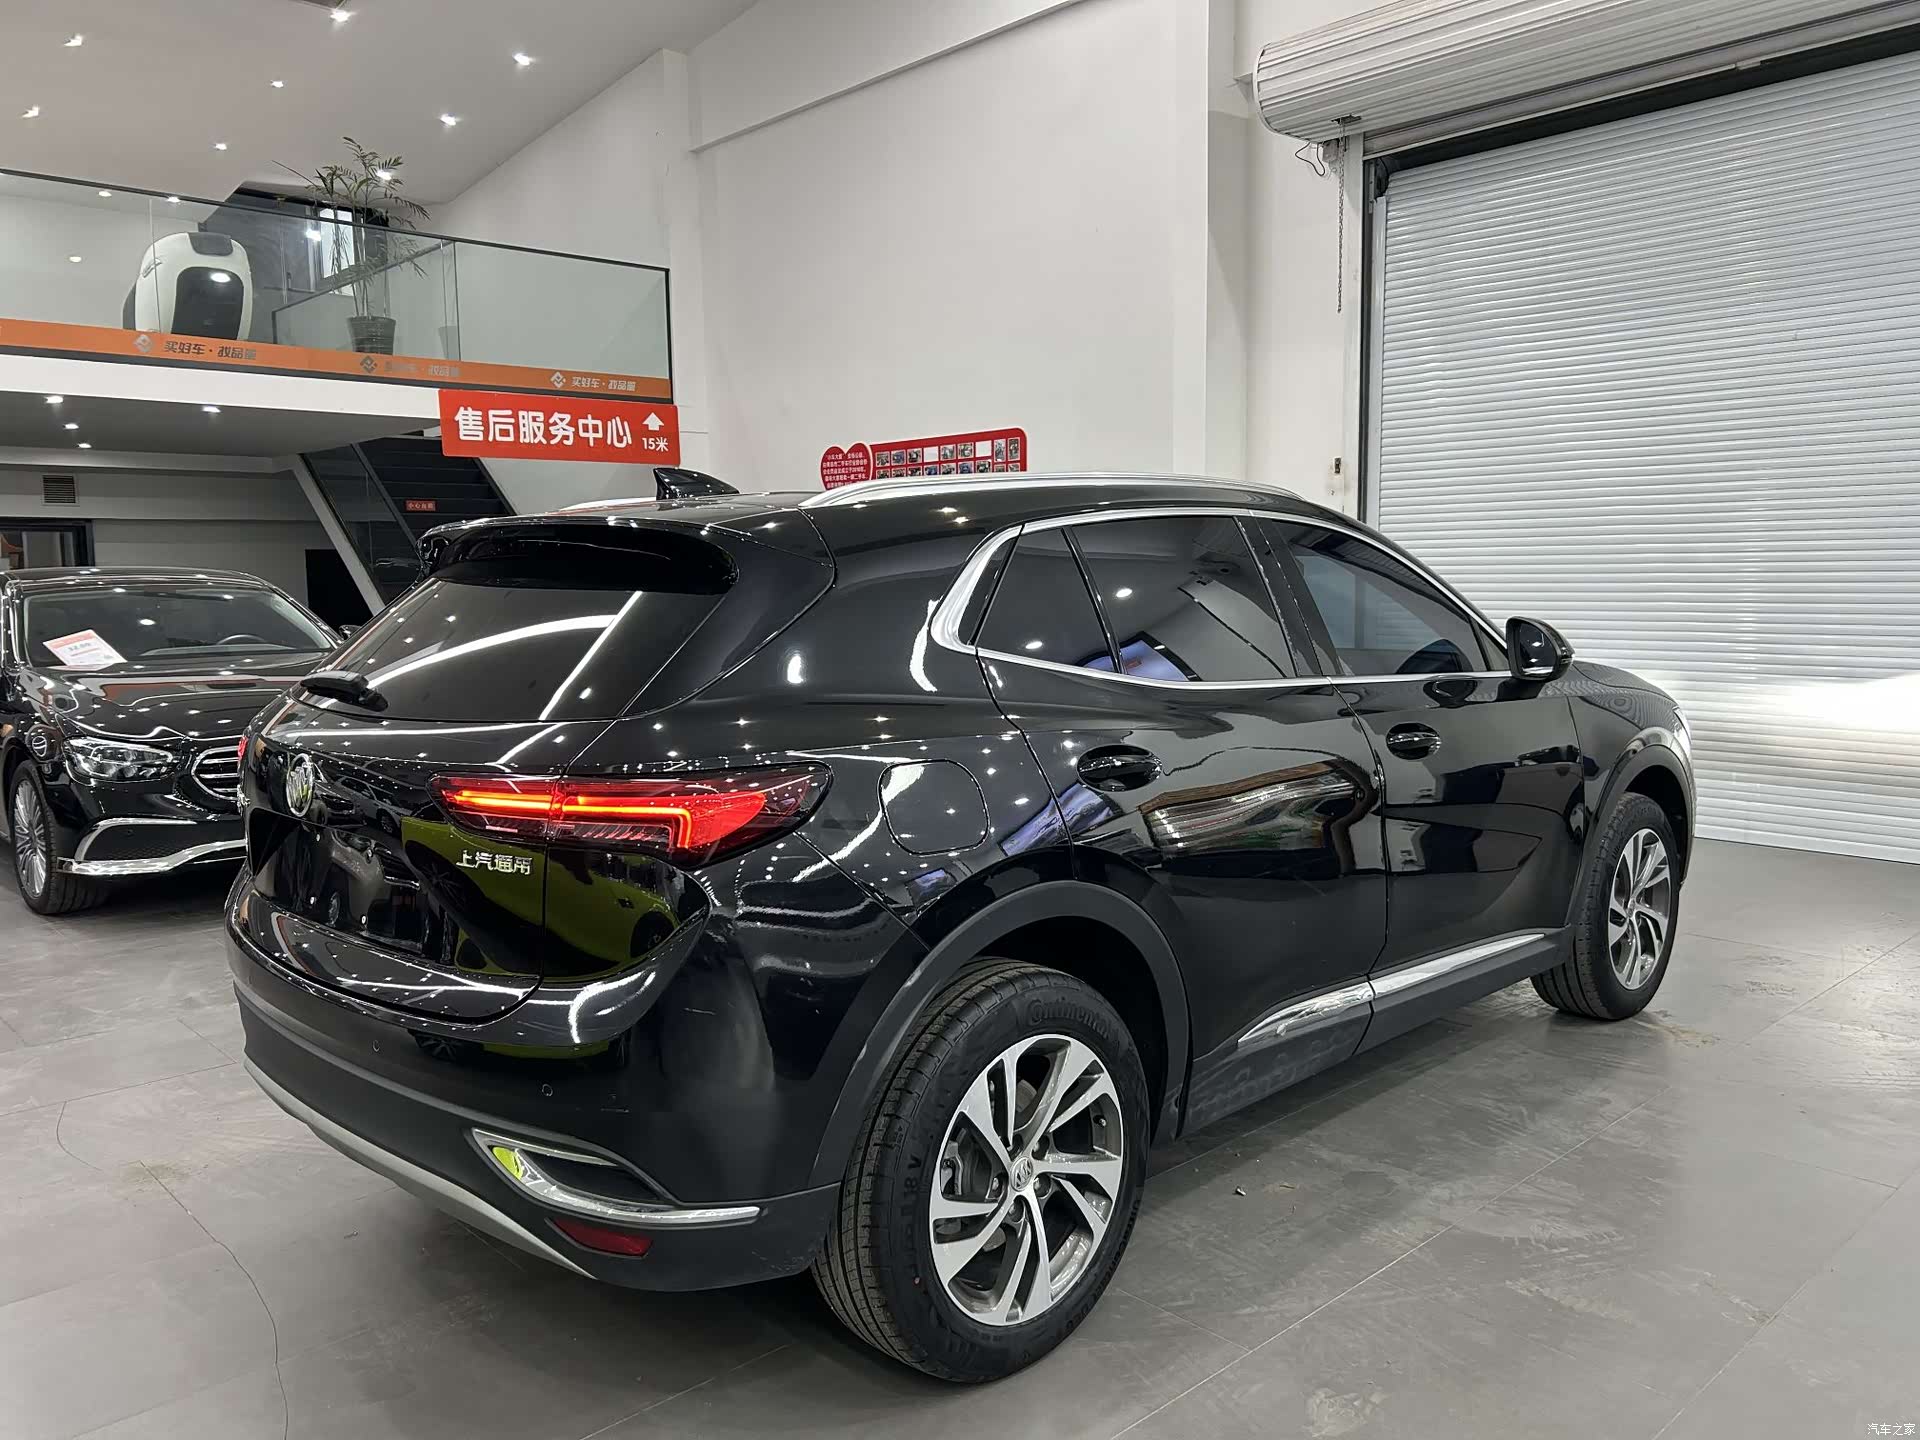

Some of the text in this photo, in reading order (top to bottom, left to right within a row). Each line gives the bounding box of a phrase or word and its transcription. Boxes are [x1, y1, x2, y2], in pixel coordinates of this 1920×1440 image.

[454, 406, 632, 448] 售后服务中心
[641, 436, 669, 453] 15米
[456, 849, 533, 875] 上汽通用
